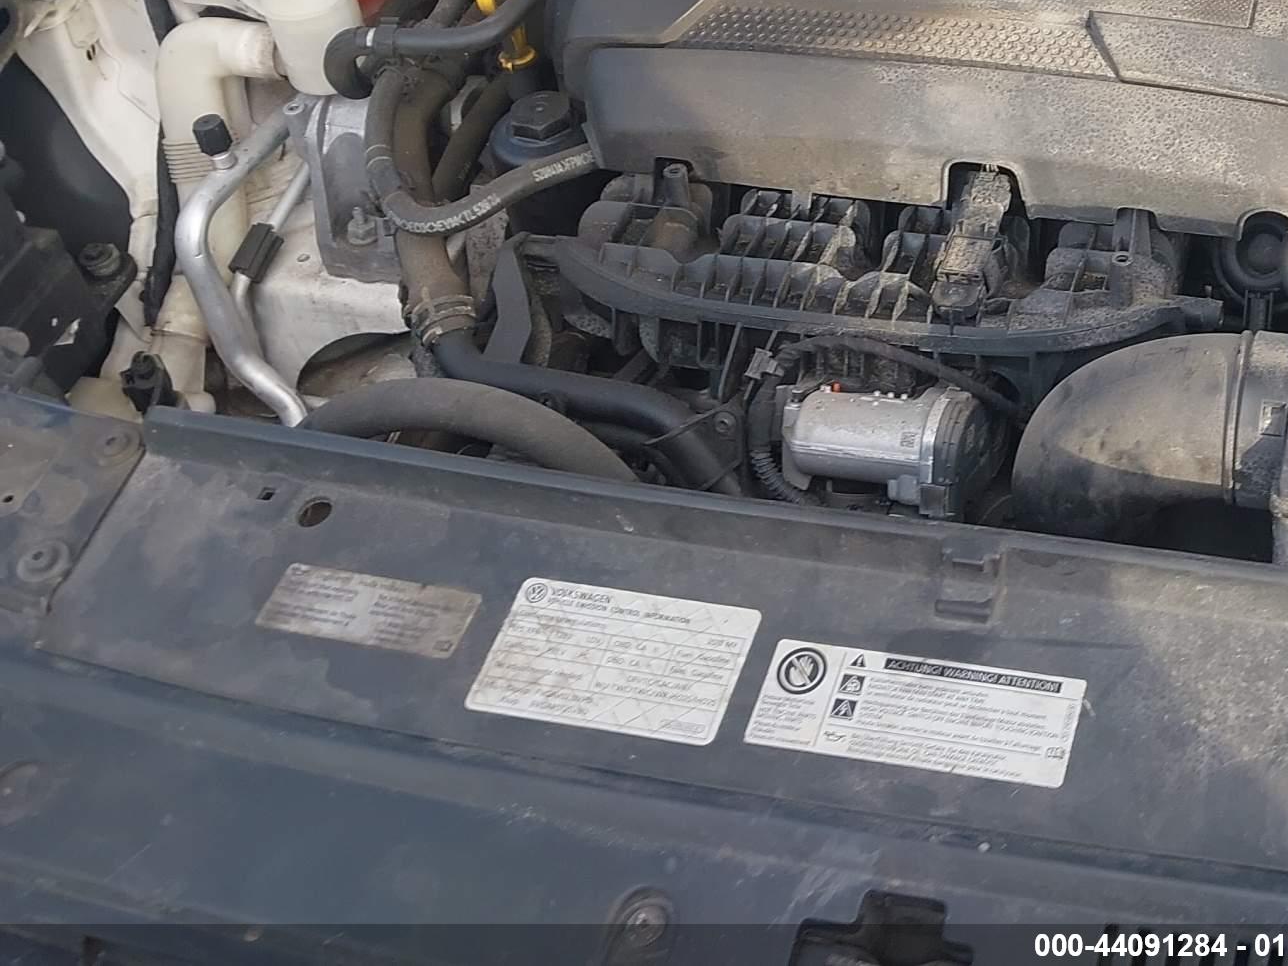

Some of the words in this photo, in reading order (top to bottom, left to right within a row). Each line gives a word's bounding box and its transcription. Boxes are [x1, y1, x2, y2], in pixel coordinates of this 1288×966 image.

[549, 587, 613, 604] VOLKSWAGEN
[887, 660, 942, 676] ACHTUNG!
[943, 667, 998, 684] WARNING!
[997, 677, 1060, 693] ATTENTION!
